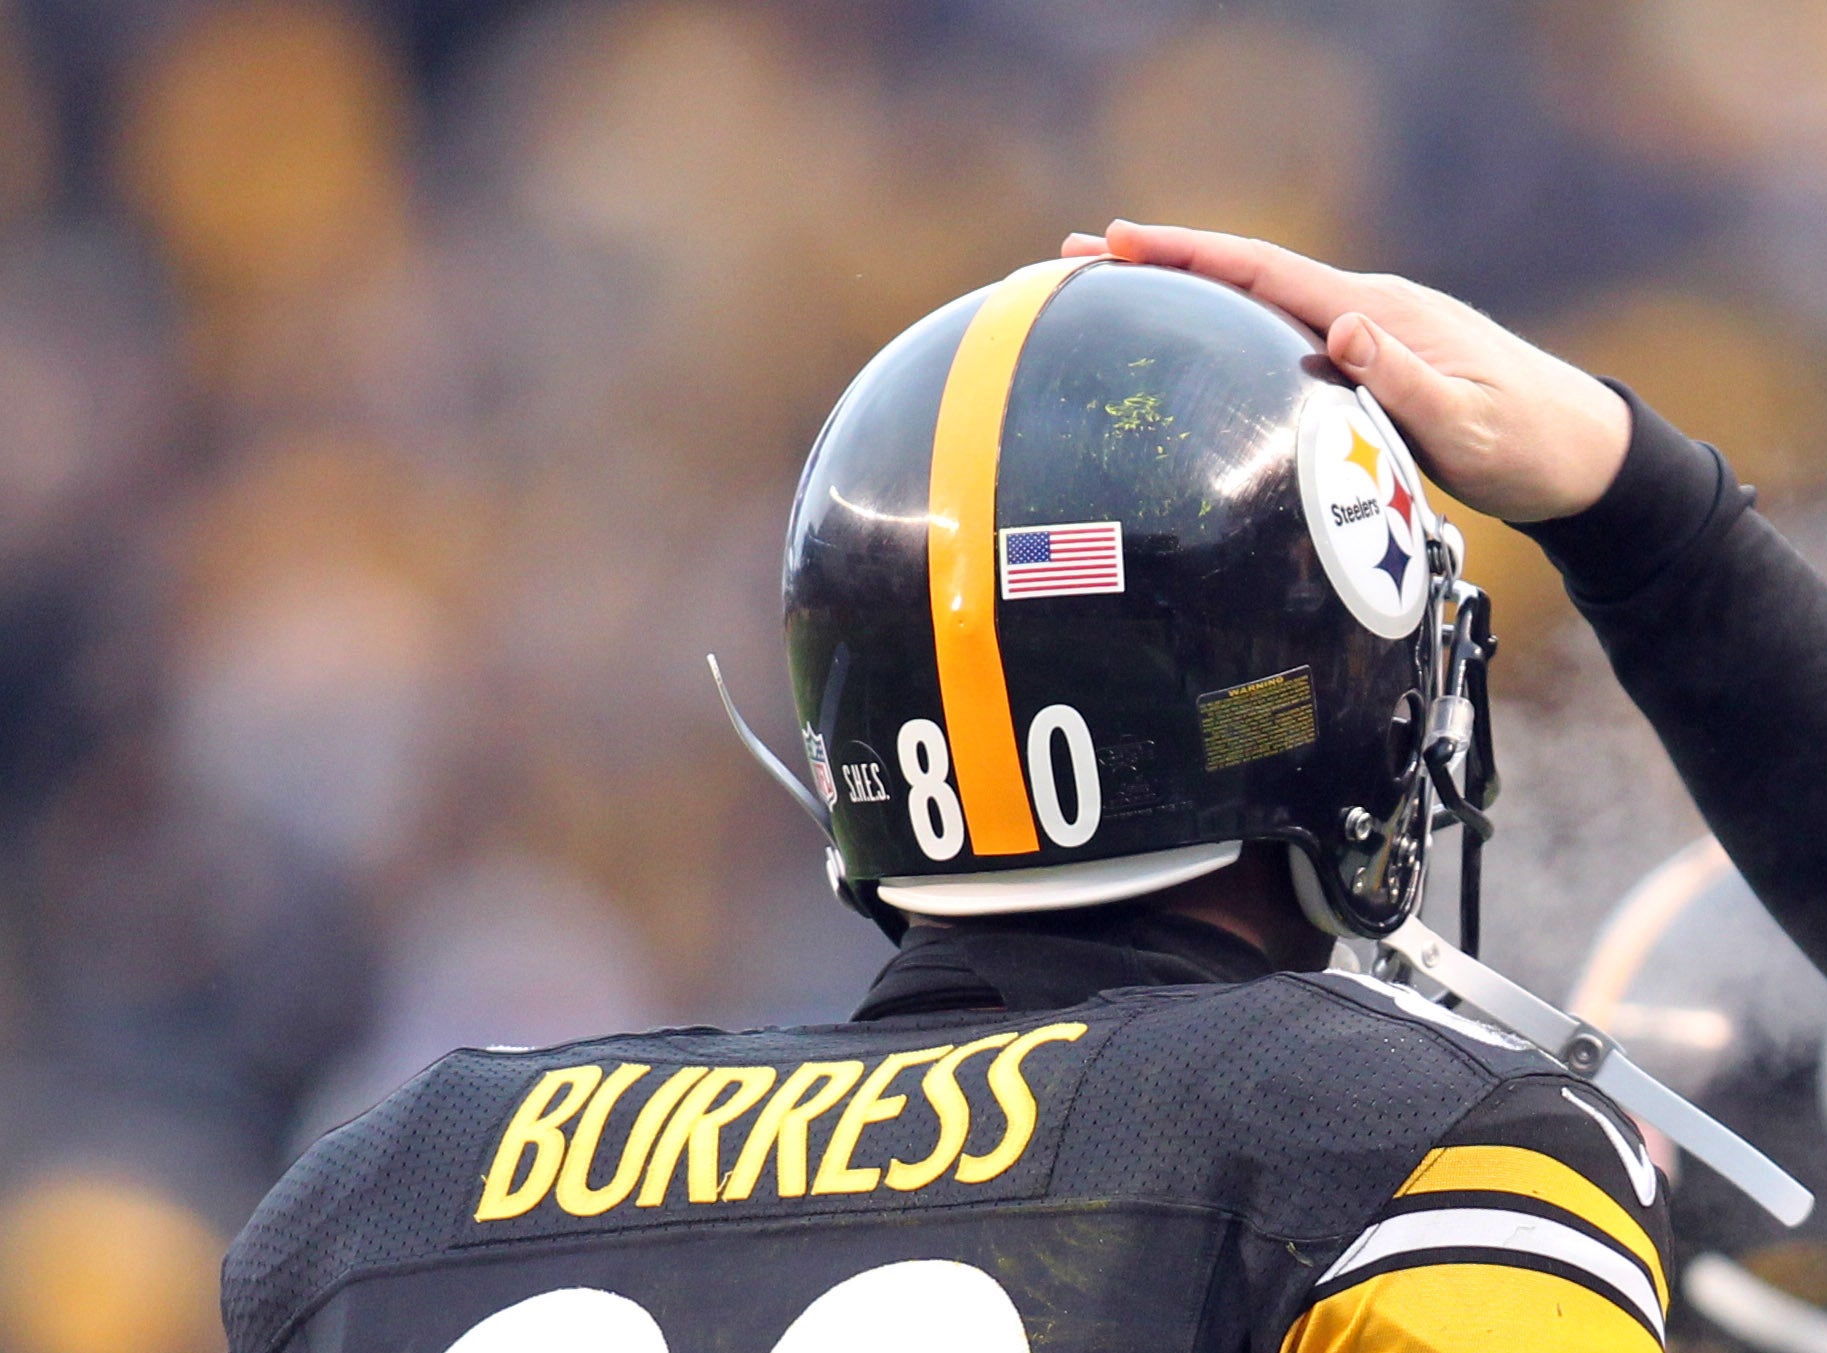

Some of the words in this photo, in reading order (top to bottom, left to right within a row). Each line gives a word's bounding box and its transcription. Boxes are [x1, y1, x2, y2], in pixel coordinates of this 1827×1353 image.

[1330, 496, 1380, 527] Steelers
[1227, 676, 1285, 697] WARNING
[473, 1022, 1088, 1223] BURRESS
